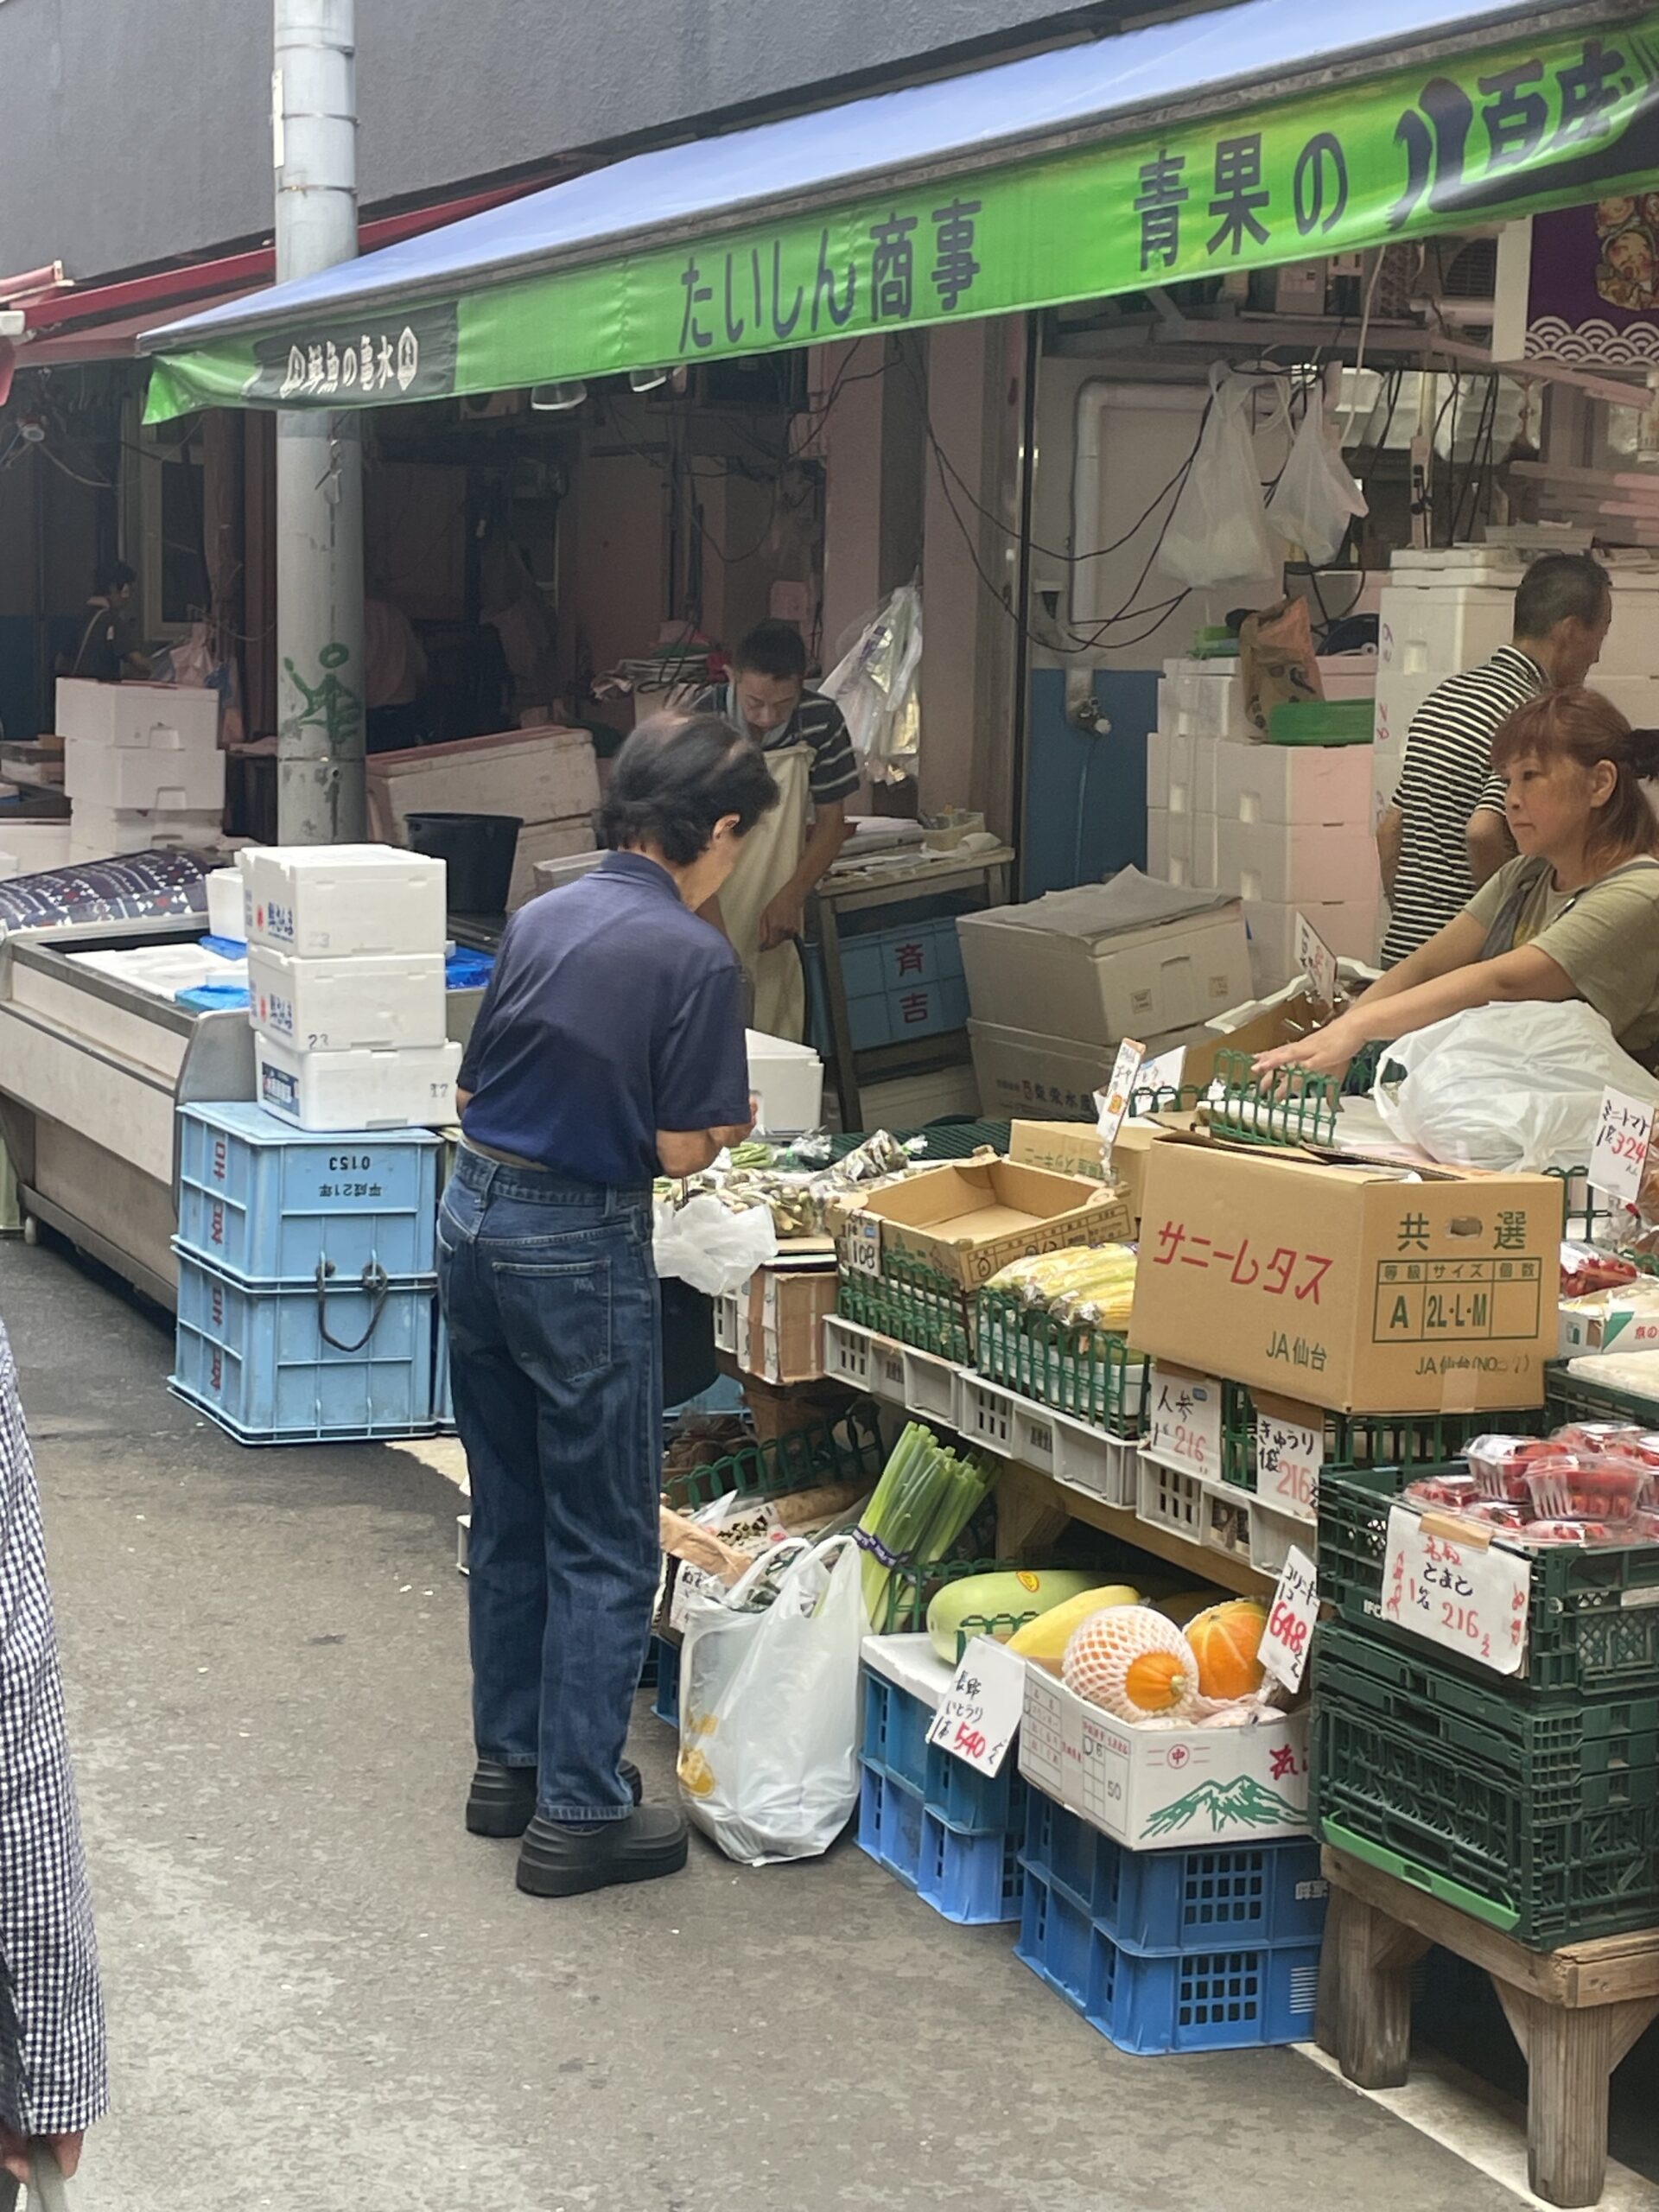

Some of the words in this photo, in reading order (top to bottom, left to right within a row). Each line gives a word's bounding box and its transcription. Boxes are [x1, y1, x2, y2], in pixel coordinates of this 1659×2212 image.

[677, 197, 982, 353] たいしん商事
[1611, 1131, 1646, 1164] 324
[317, 1182, 383, 1198] 平成21年
[1153, 1220, 1334, 1306] サニーレタス
[1433, 1263, 1484, 1279] サイズ
[1389, 1295, 1409, 1329] A
[1266, 1331, 1327, 1372] JA仙台
[1158, 1384, 1194, 1423] 人参
[1173, 1425, 1206, 1462] 216
[1259, 1420, 1314, 1456] きゅうり
[1276, 1459, 1311, 1504] 216
[1423, 1561, 1473, 1597] とまと
[1269, 1600, 1307, 1654] 648
[1441, 1601, 1480, 1639] 216
[953, 1721, 986, 1759] 540
